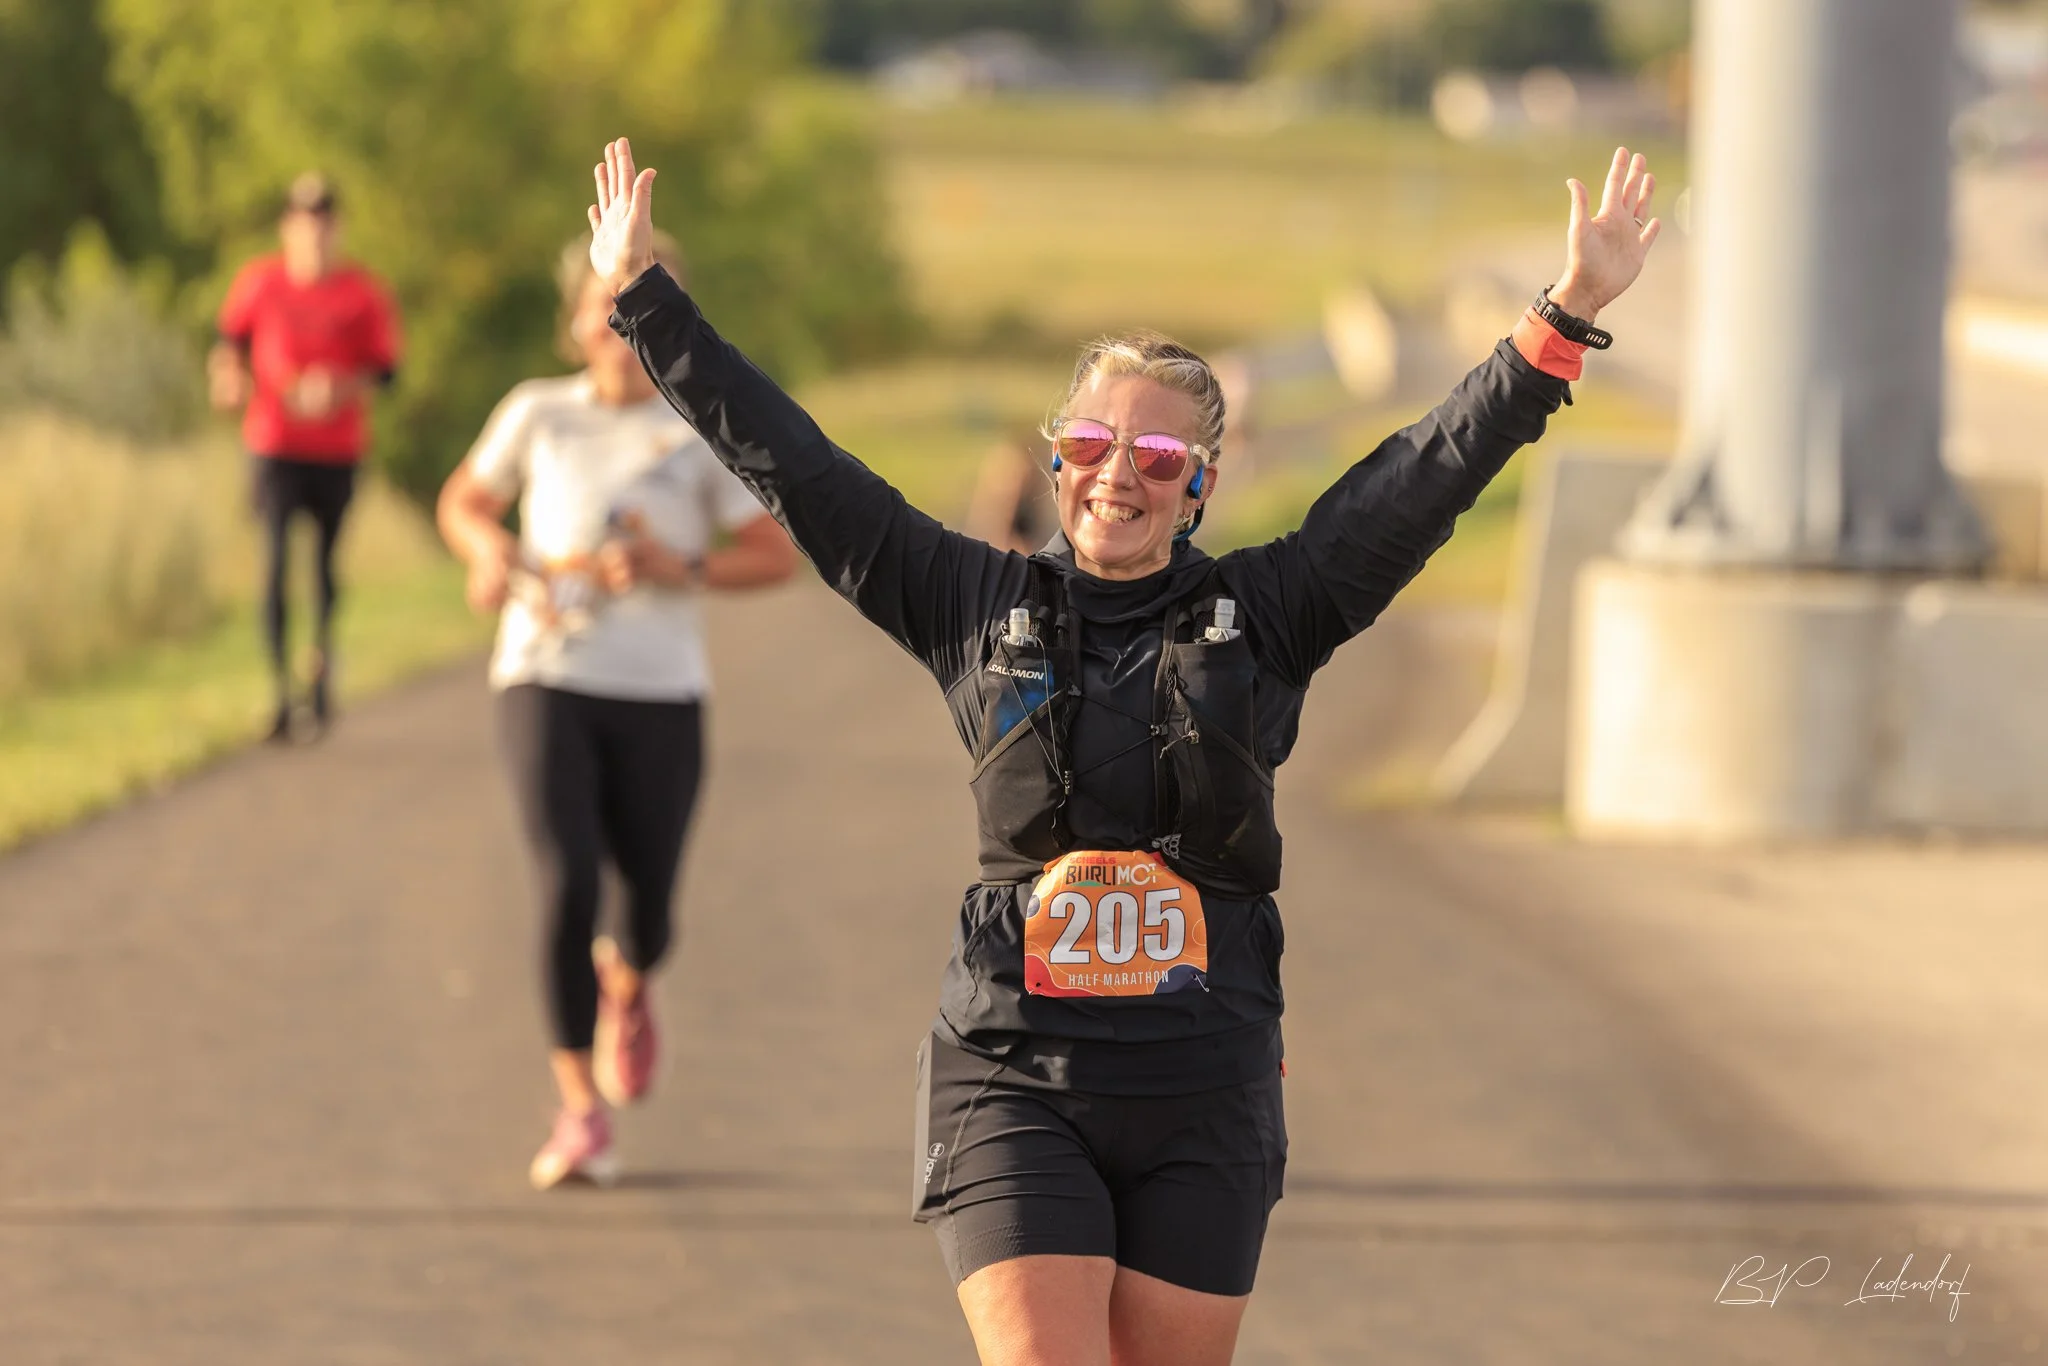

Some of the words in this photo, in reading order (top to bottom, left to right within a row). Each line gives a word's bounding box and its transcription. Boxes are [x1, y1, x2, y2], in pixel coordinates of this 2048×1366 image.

[988, 663, 1045, 681] SALOMON
[1069, 856, 1117, 865] SCHEELS
[1048, 887, 1186, 965] 205
[1068, 973, 1100, 987] HALF
[1103, 970, 1170, 986] MARATHON
